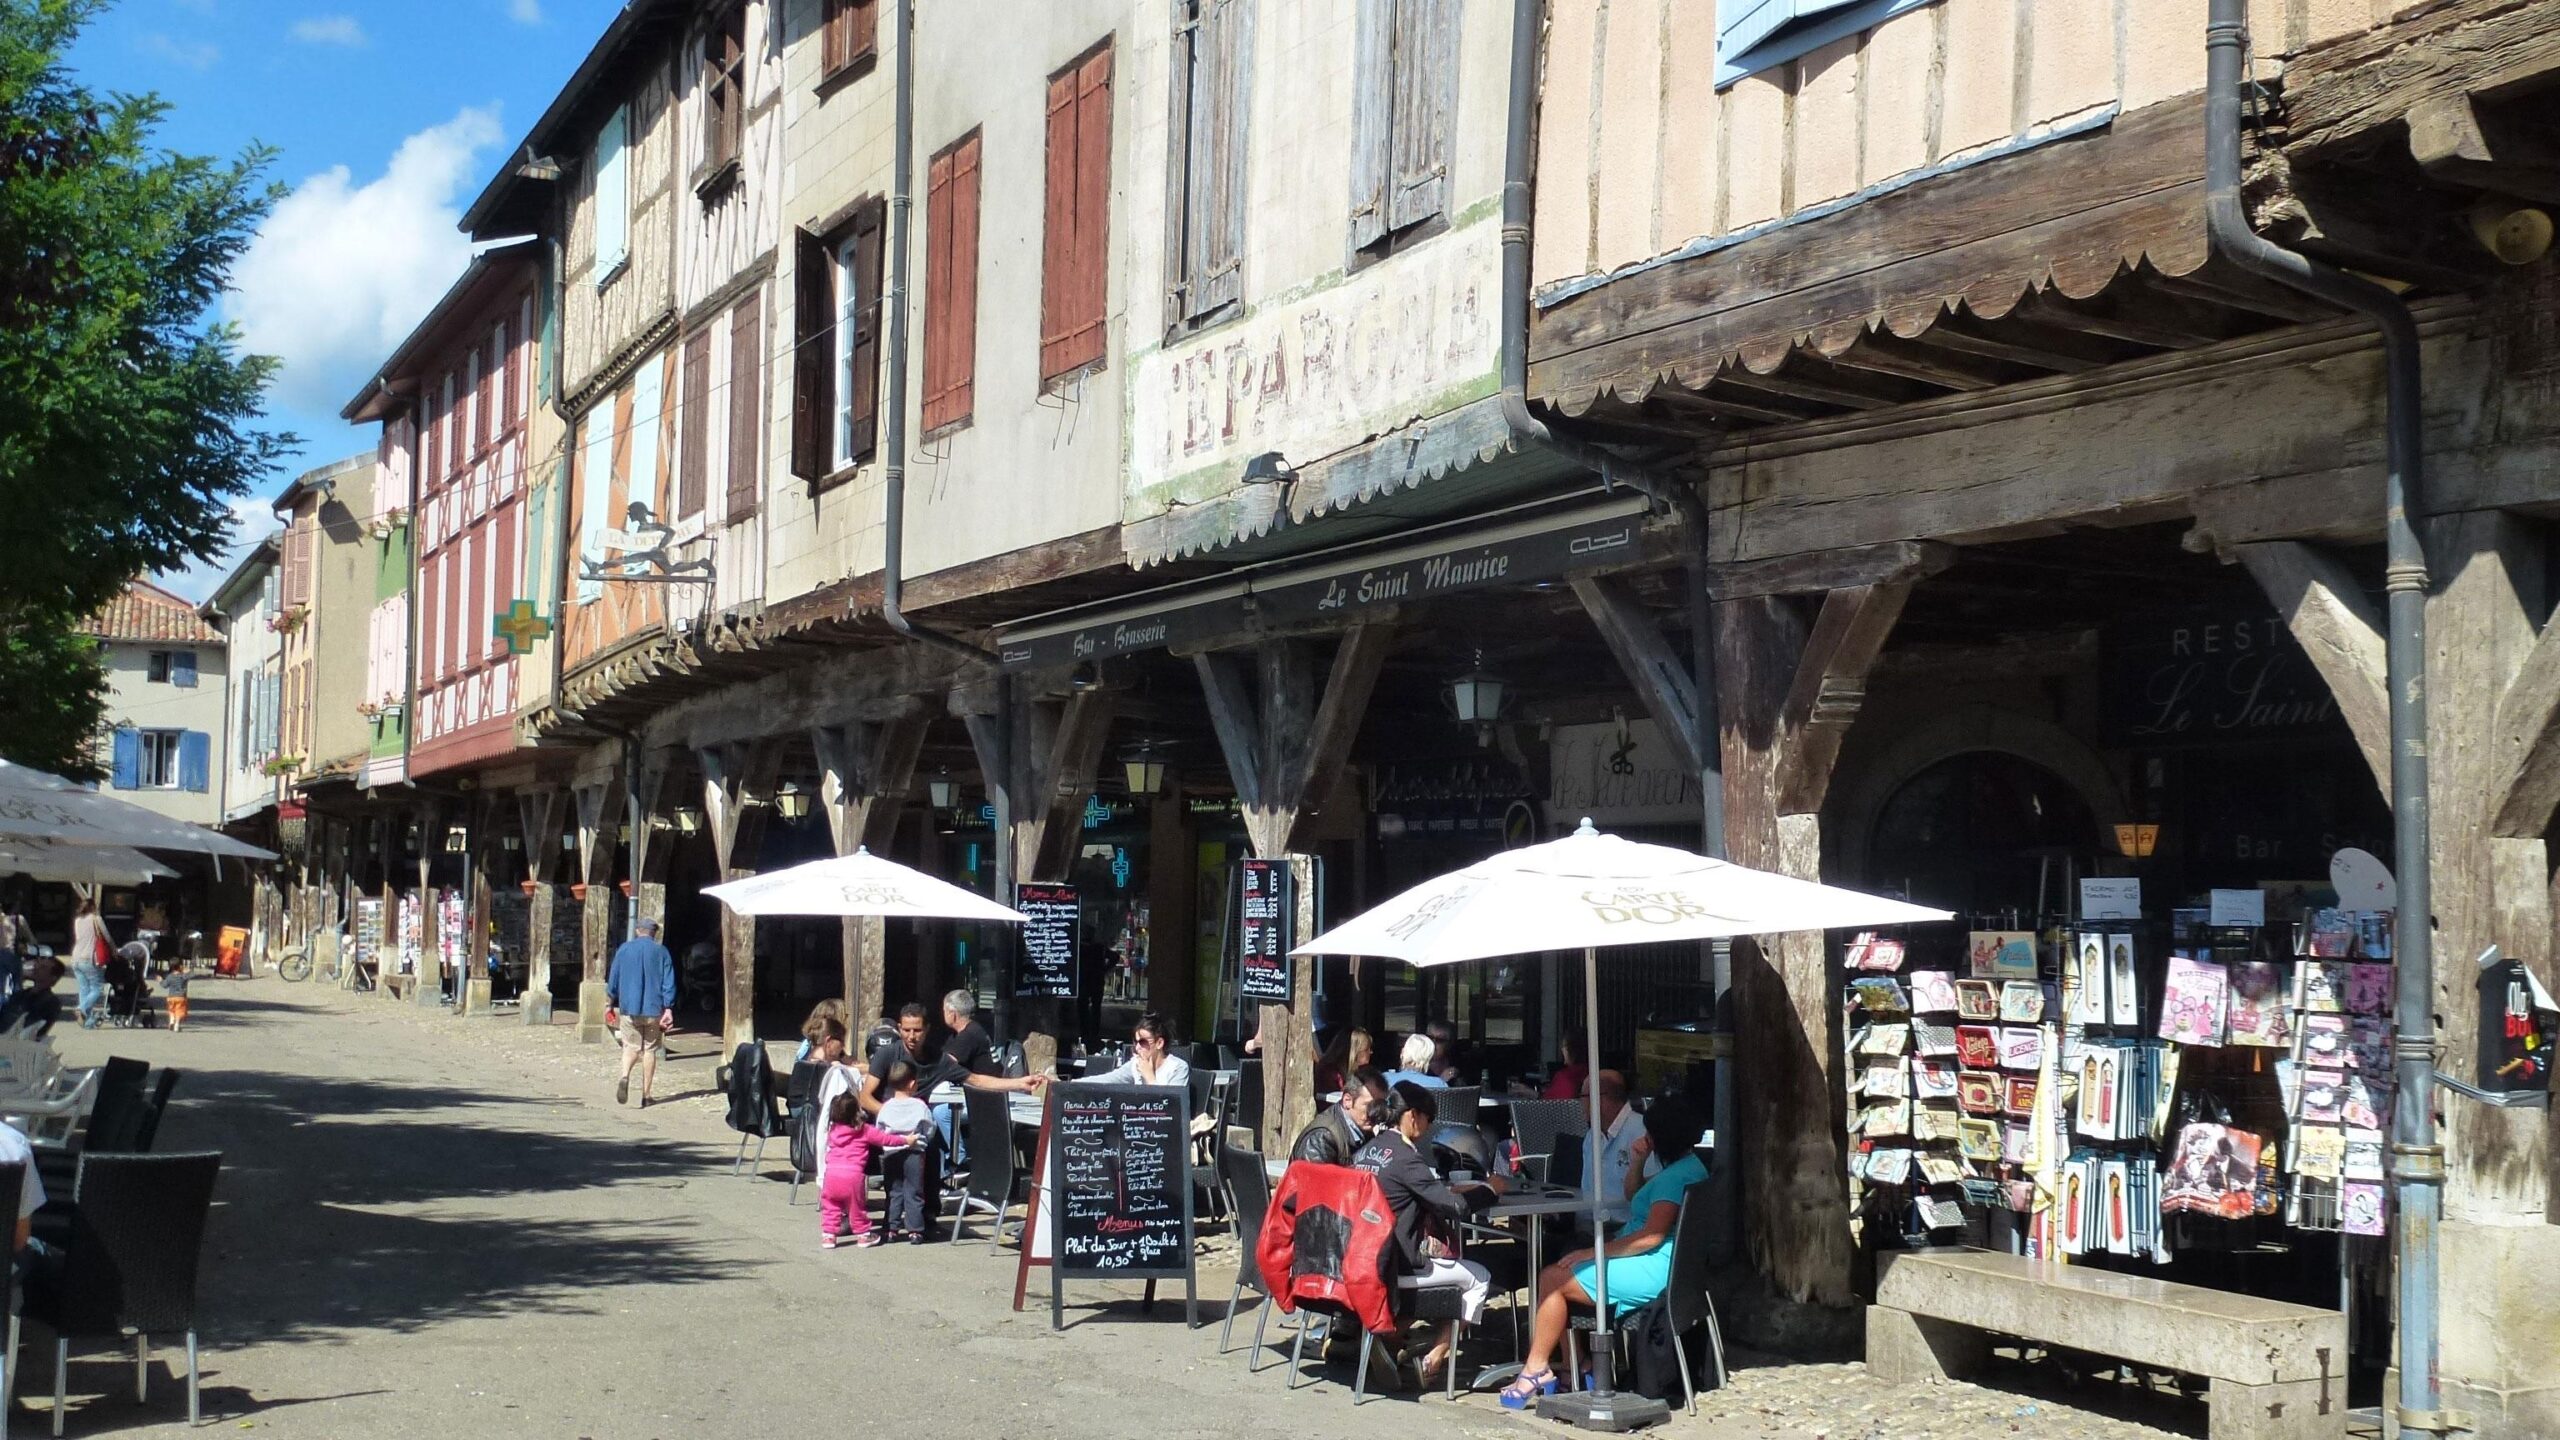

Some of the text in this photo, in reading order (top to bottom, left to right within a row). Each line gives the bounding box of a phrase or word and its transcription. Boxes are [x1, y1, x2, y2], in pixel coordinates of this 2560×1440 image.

[1318, 549, 1509, 611] Le Saint Maurice
[1073, 633, 1095, 657] Bar
[1114, 619, 1166, 650] Brasserie
[2173, 617, 2285, 656] REST
[1580, 890, 1694, 906] CARTE
[1065, 1235, 1092, 1255] Plat
[1090, 1235, 1106, 1253] du
[1130, 1239, 1138, 1249] +
[1145, 1231, 1169, 1247] Boule
[1169, 1234, 1178, 1246] de
[1140, 1247, 1161, 1262] glace
